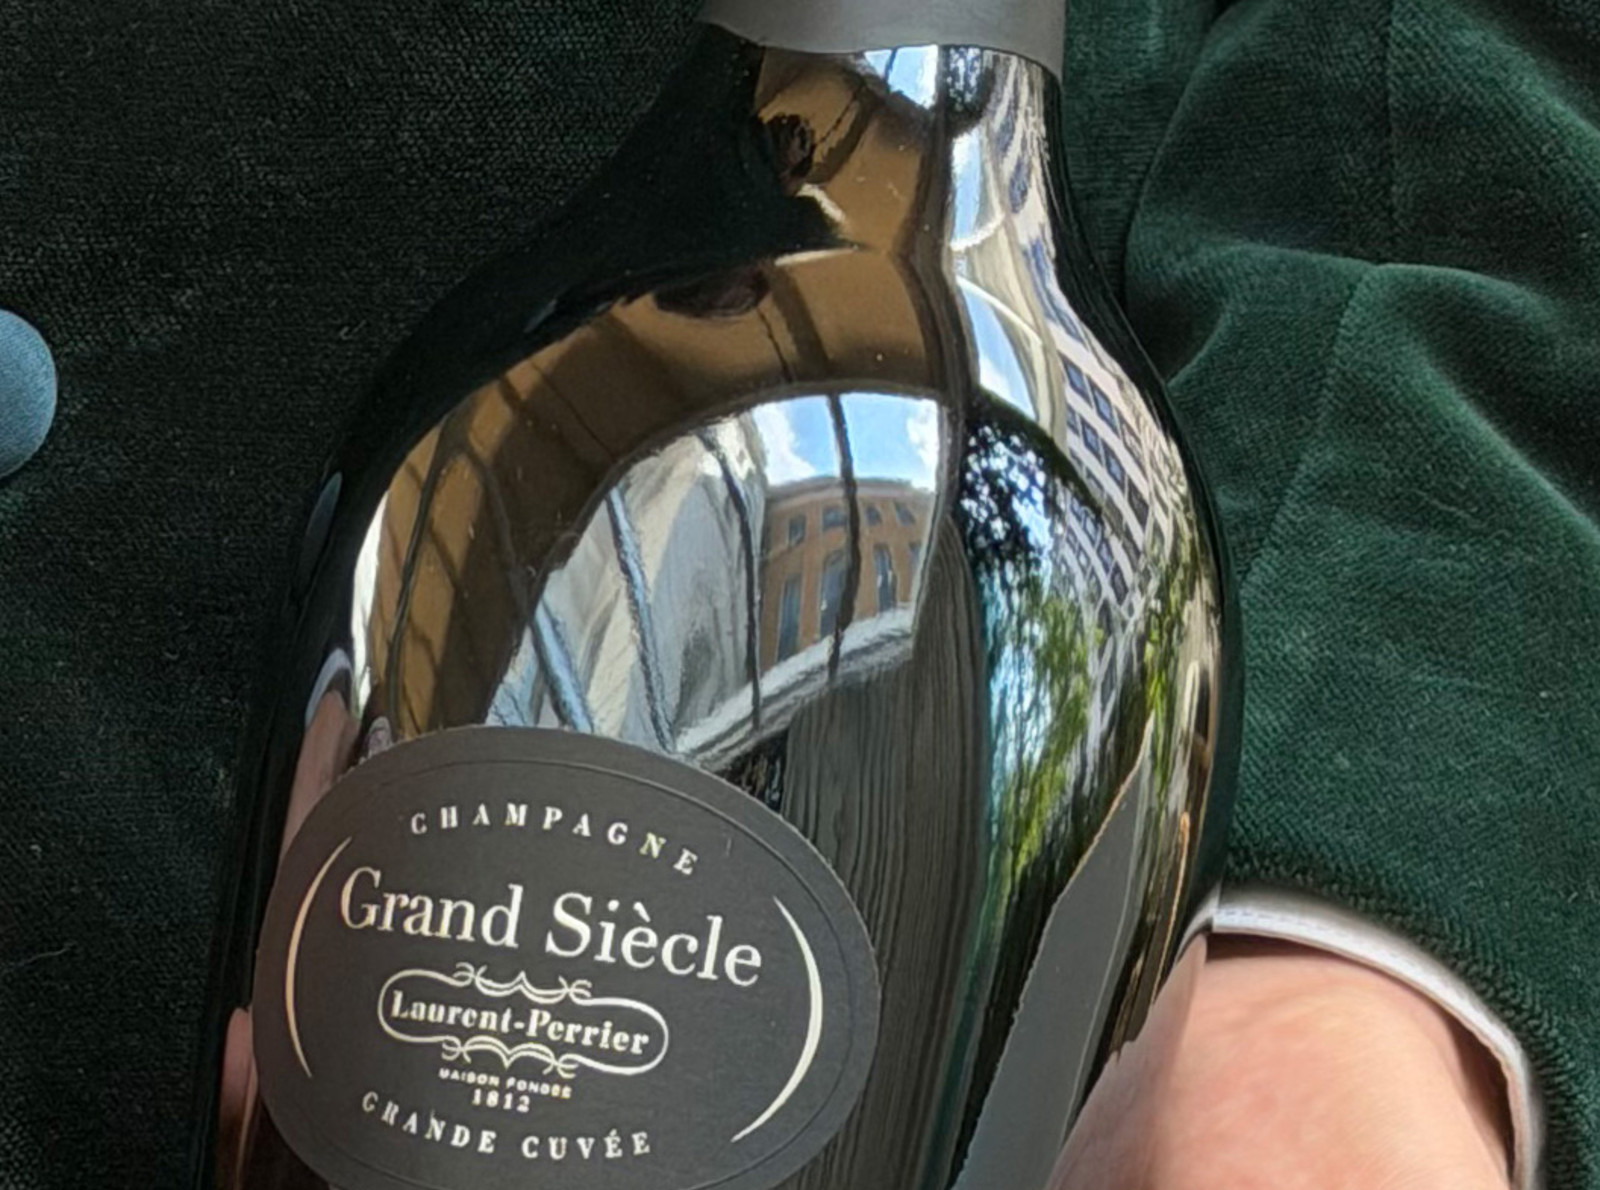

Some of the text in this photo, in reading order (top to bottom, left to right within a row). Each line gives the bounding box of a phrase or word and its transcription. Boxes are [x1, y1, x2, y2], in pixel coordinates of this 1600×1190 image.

[410, 802, 699, 875] CHAMPAGNE
[339, 865, 763, 987] Grand Siècle
[390, 990, 651, 1055] Laurent-Perrier
[438, 1067, 500, 1087] MAISON
[472, 1088, 531, 1113] 1812
[361, 1090, 651, 1161] GRANDE CUVÉE
